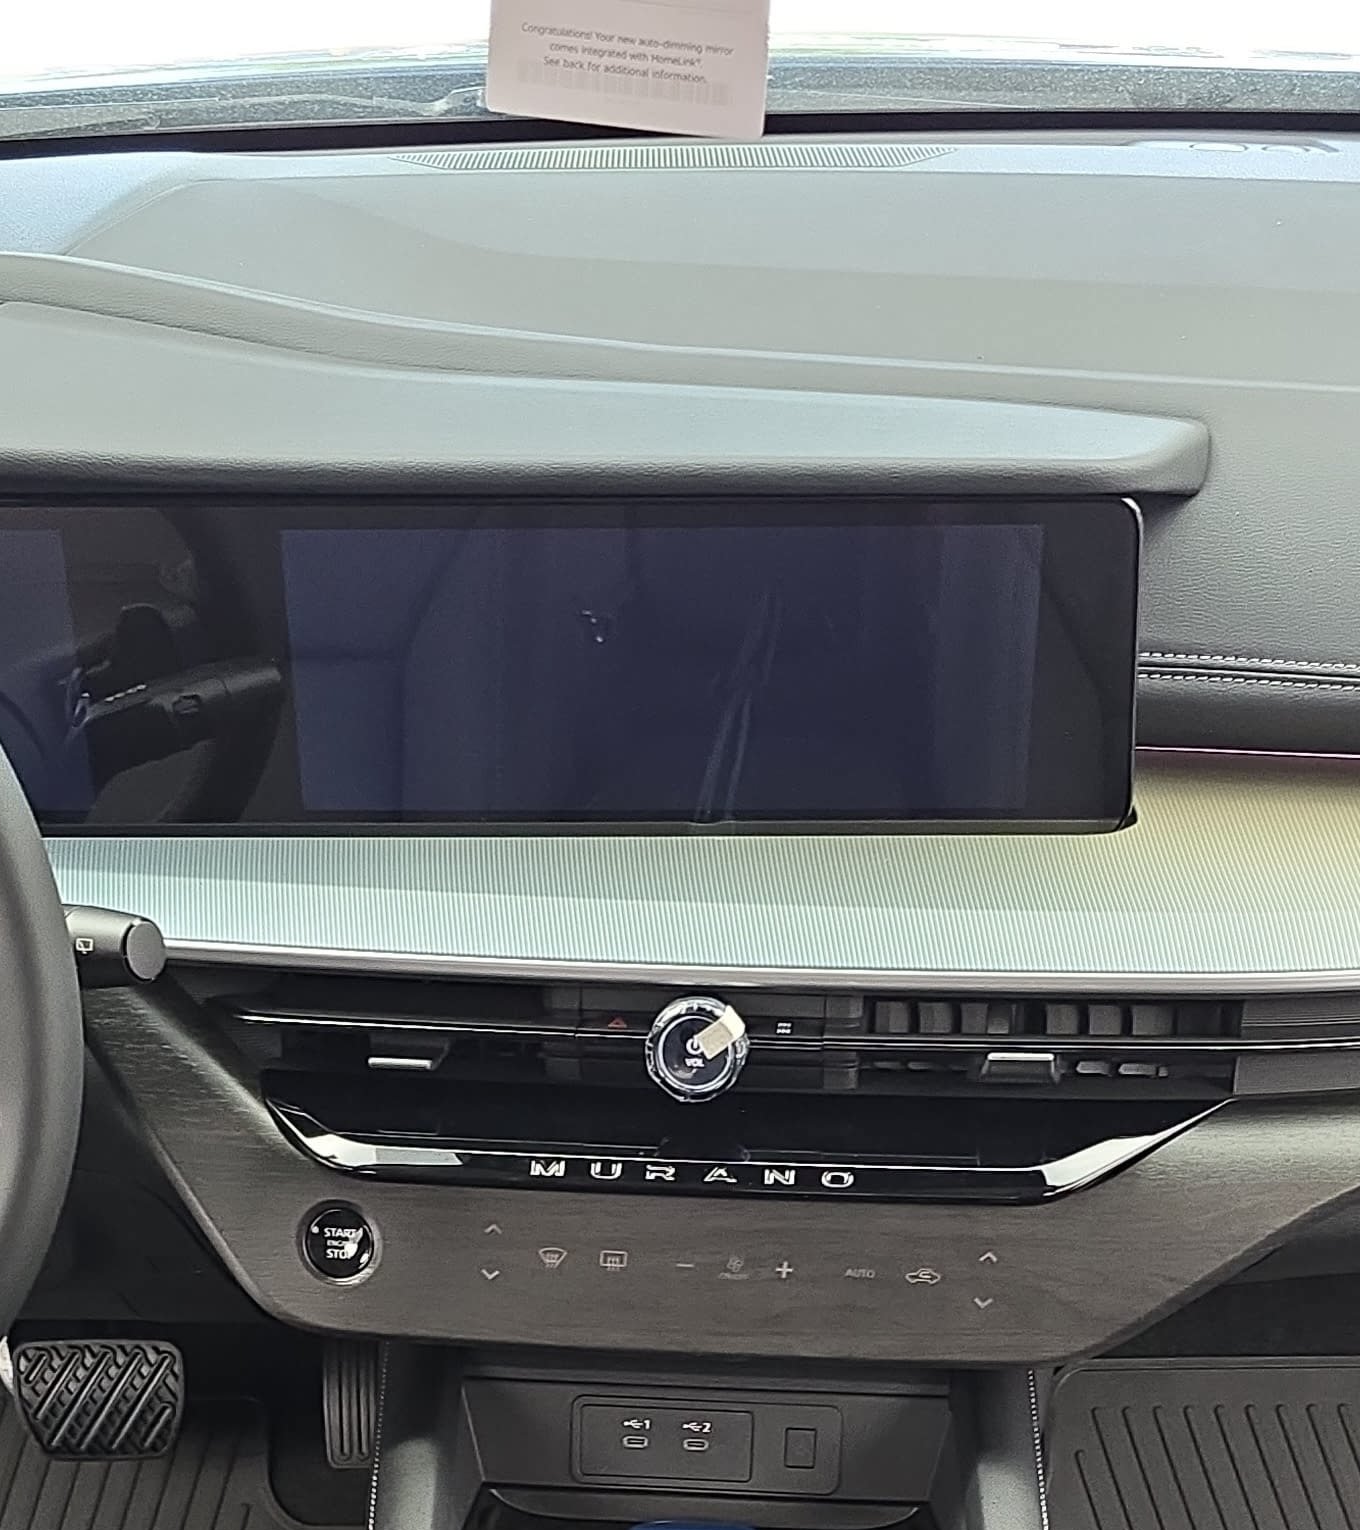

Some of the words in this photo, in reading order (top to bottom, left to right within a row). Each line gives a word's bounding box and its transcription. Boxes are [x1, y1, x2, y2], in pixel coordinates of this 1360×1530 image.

[521, 22, 592, 40] Congratulations!
[594, 32, 615, 42] Your
[617, 36, 636, 45] new
[638, 38, 703, 55] auto-dimming
[705, 45, 734, 56] mirror
[550, 43, 578, 54] comes
[581, 45, 627, 60] integrated
[629, 52, 649, 62] with
[543, 56, 560, 66] See
[562, 58, 585, 69] back
[587, 61, 600, 72] for
[604, 64, 649, 78] additional
[529, 1159, 855, 1188] MURANO
[844, 1267, 876, 1278] AUTO
[643, 1419, 651, 1430] 1
[702, 1422, 712, 1433] 2
